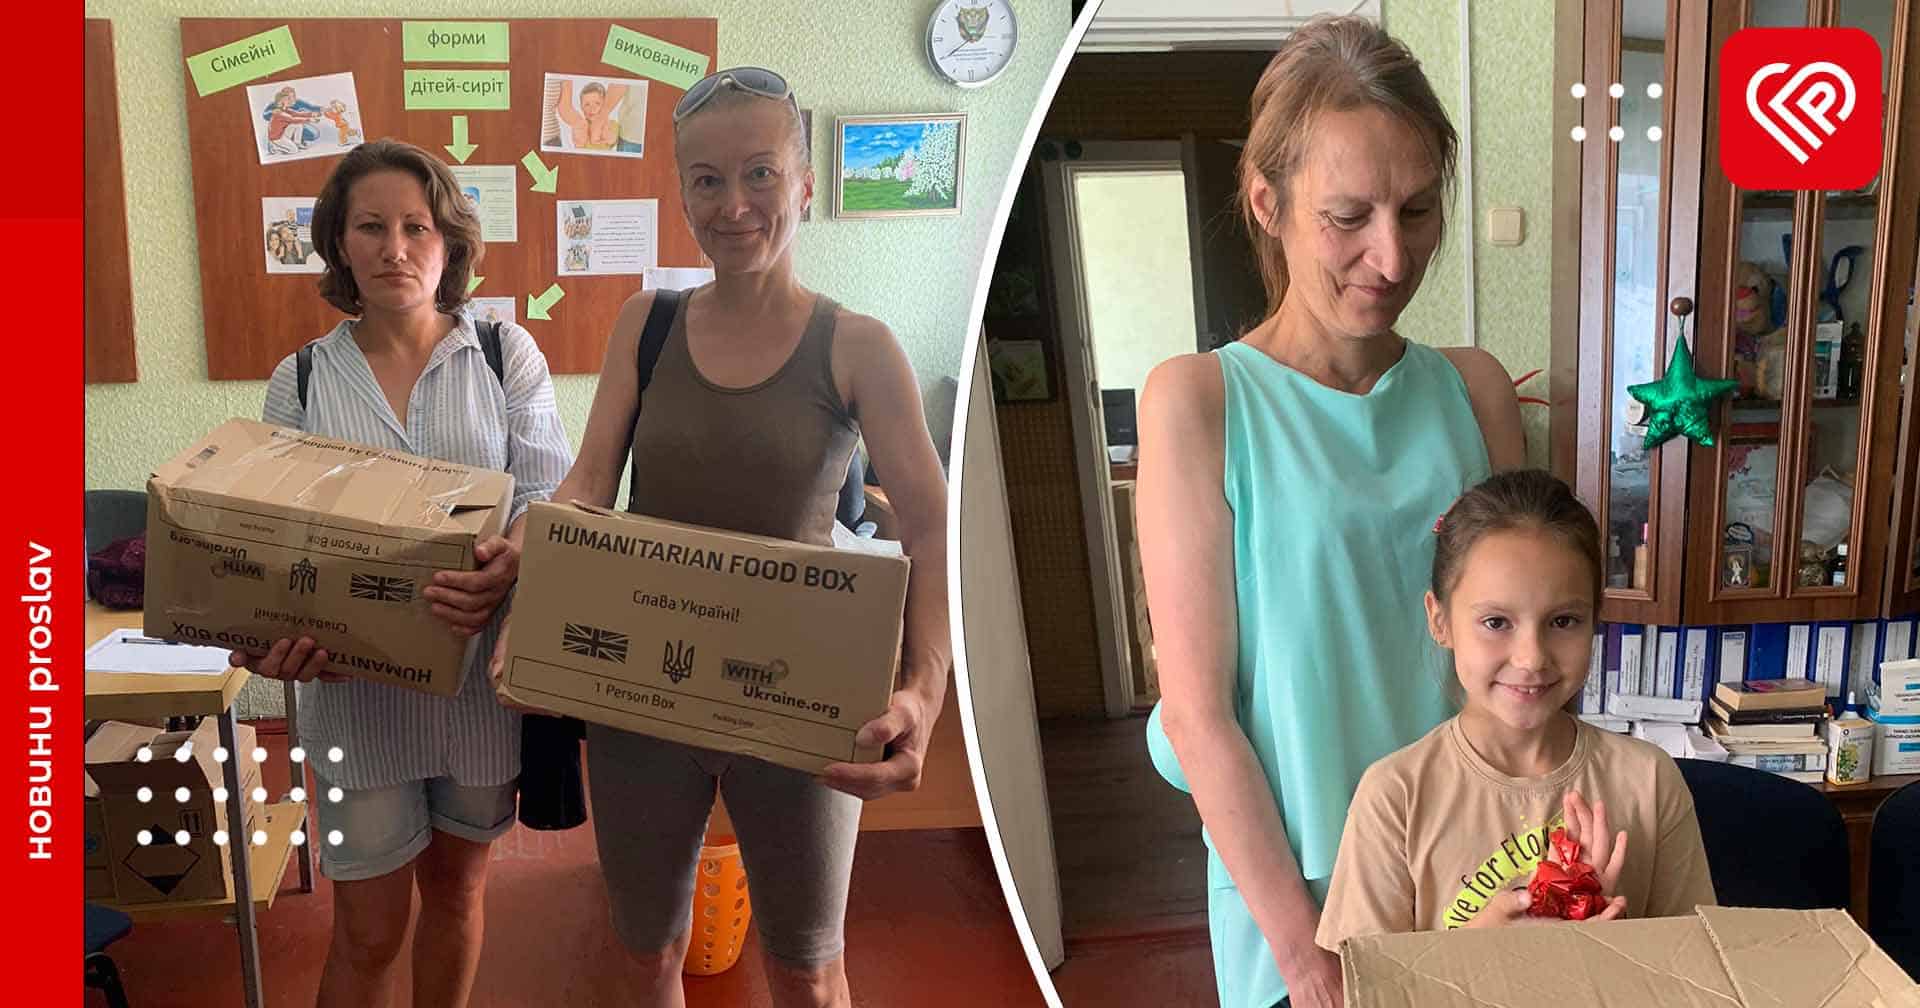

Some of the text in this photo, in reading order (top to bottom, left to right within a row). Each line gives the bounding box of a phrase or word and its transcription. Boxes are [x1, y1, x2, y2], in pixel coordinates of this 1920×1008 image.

[427, 29, 486, 49] форми
[210, 41, 276, 74] Сімейні
[614, 38, 699, 76] виховання
[410, 77, 505, 97] дітей-сиріт
[169, 530, 248, 561] Ukraine.org
[306, 534, 328, 549] Box
[330, 538, 371, 556] Person
[223, 560, 262, 578] WITH
[547, 523, 859, 594] HUMANITARIAN FOOD BOX
[632, 590, 740, 624] Слава Україні!
[172, 620, 212, 641] BOX
[307, 616, 348, 634] Слава
[216, 631, 272, 651] FOOD
[726, 662, 774, 685] WITH
[606, 683, 649, 705] Person
[651, 693, 677, 712] Box
[743, 685, 841, 719] Ukraine.org
[1461, 857, 1504, 899] for
